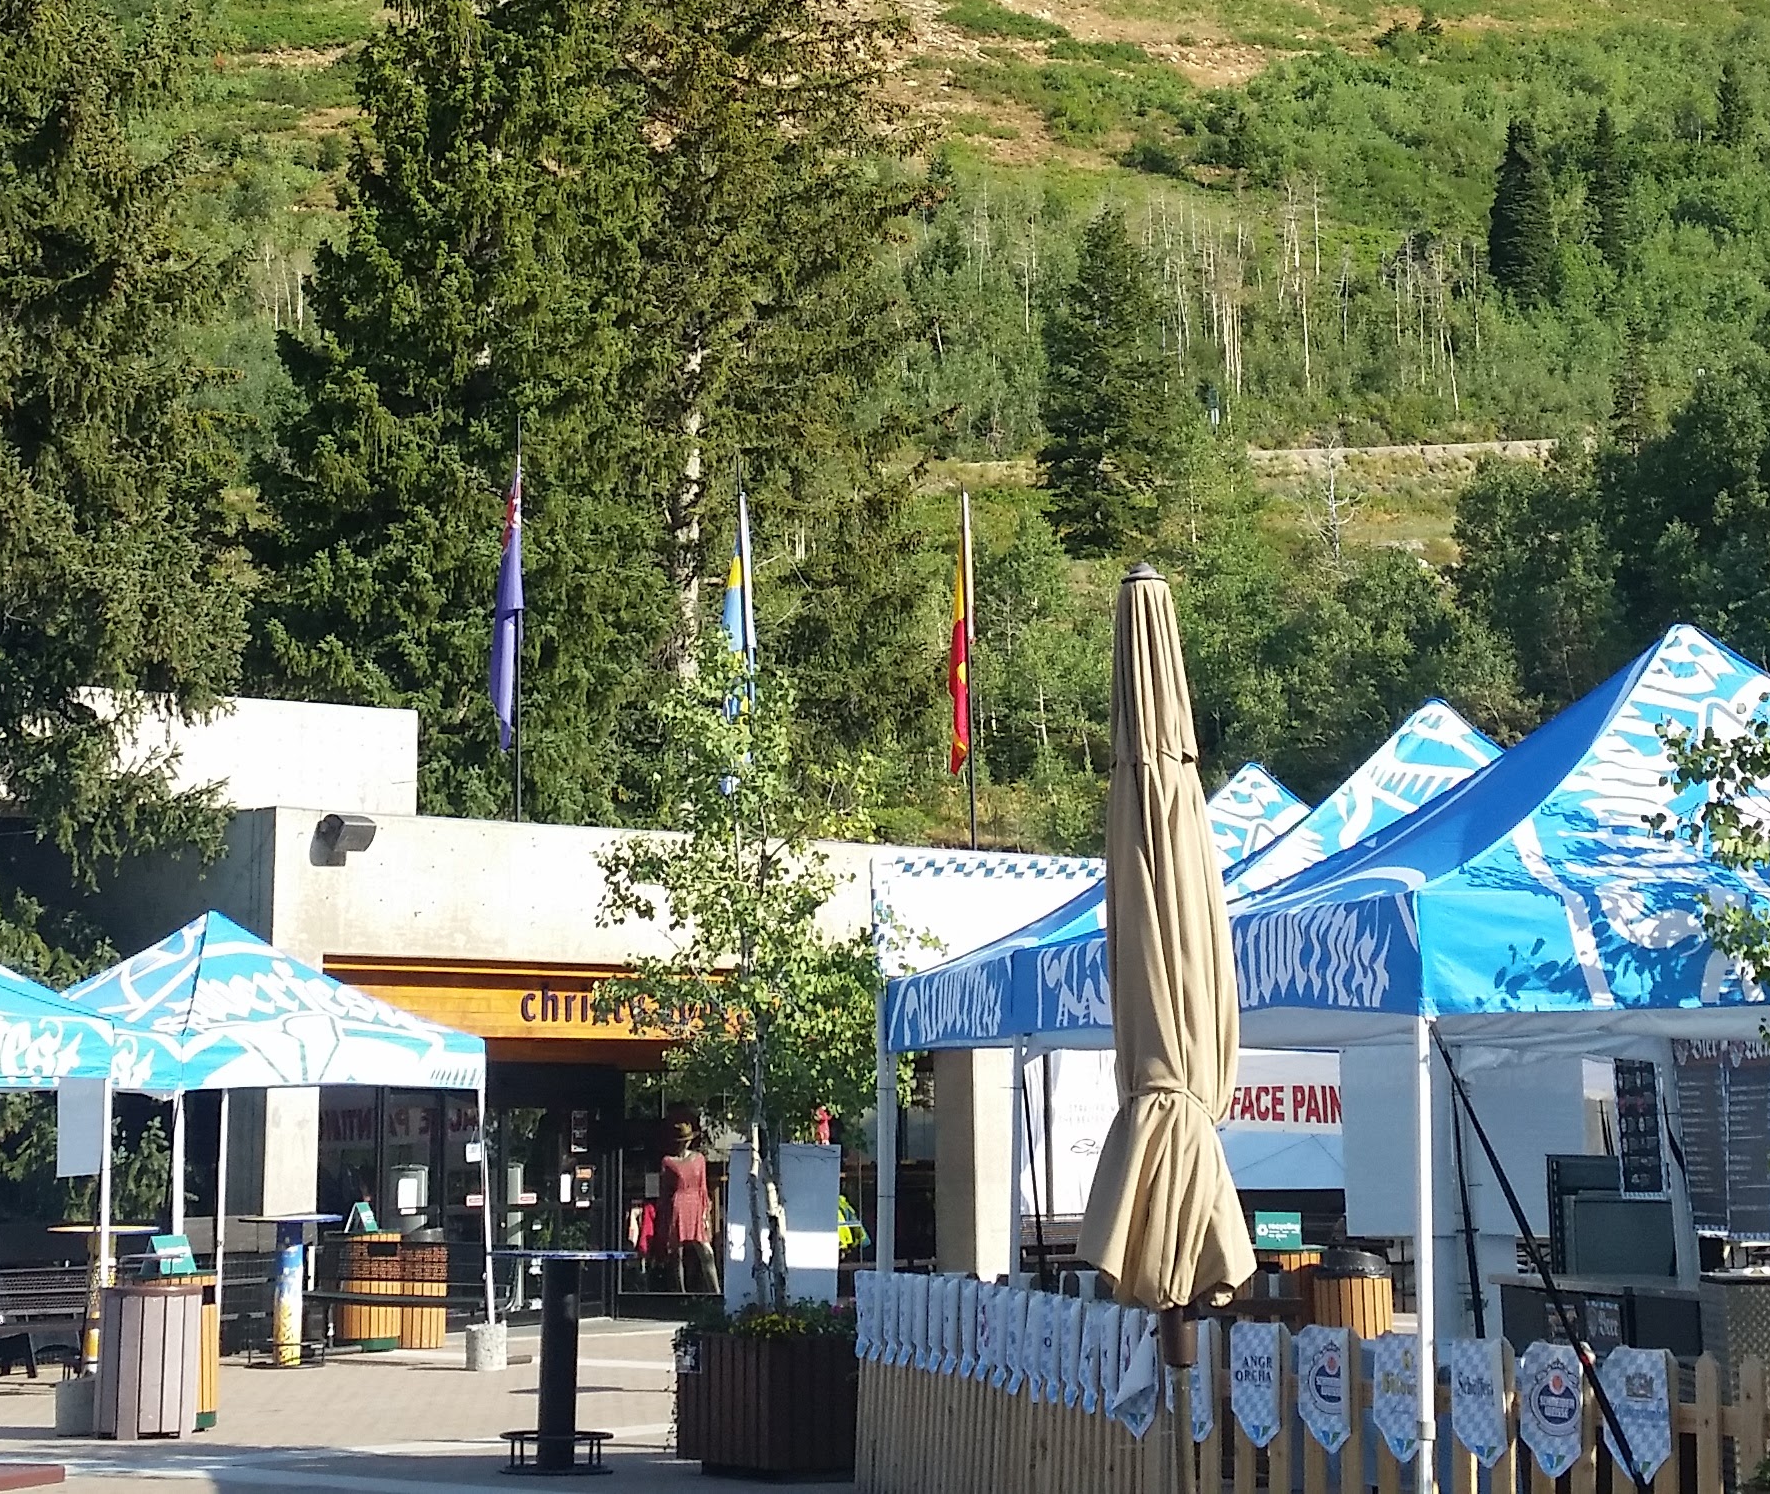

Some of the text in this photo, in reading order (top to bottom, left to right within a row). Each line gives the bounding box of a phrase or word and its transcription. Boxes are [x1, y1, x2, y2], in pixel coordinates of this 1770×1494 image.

[1232, 1086, 1342, 1123] FACE PAIN
[1243, 1355, 1272, 1368] ANGR
[1235, 1369, 1272, 1382] ORCHA
